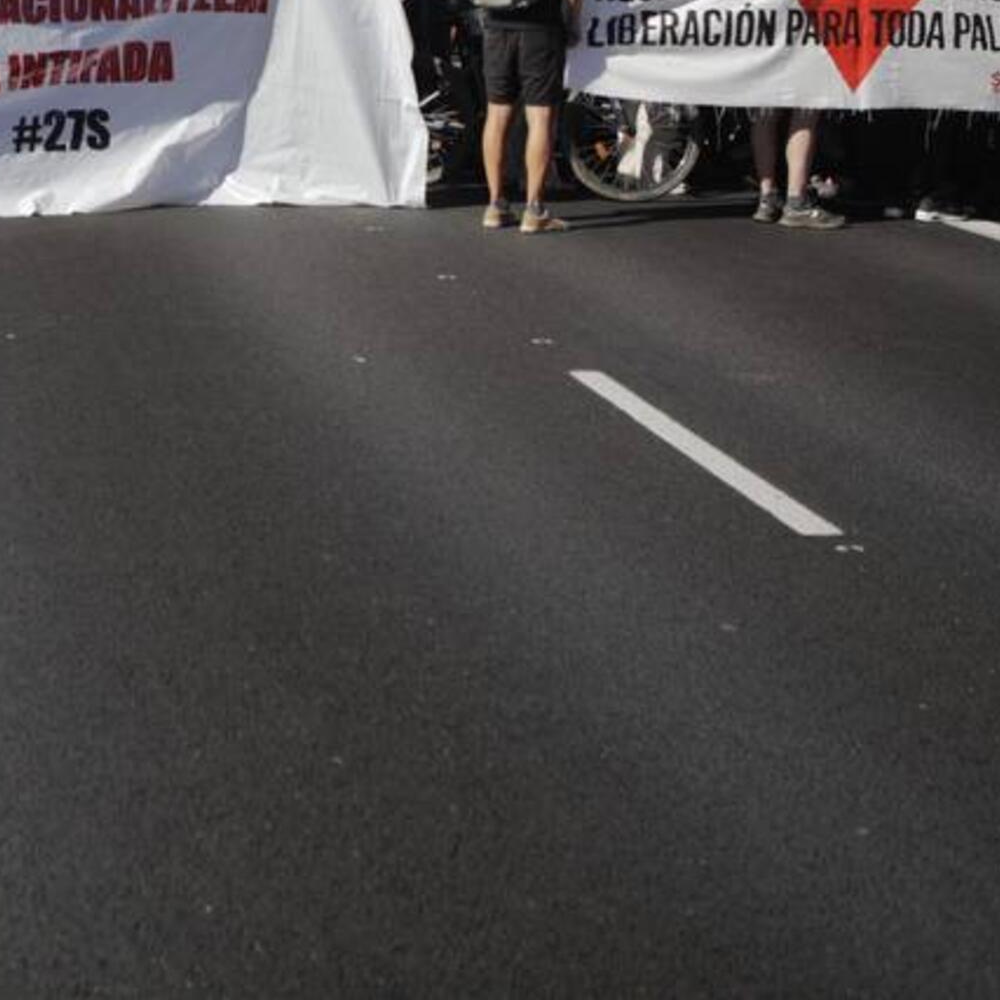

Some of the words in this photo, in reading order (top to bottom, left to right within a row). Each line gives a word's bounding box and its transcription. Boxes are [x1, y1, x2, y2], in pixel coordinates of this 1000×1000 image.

[587, 2, 777, 48] LIBERACIÓN
[786, 9, 863, 48] PARA
[873, 9, 945, 50] TODA
[8, 40, 174, 91] INTIFADA
[12, 109, 111, 153] #27S
